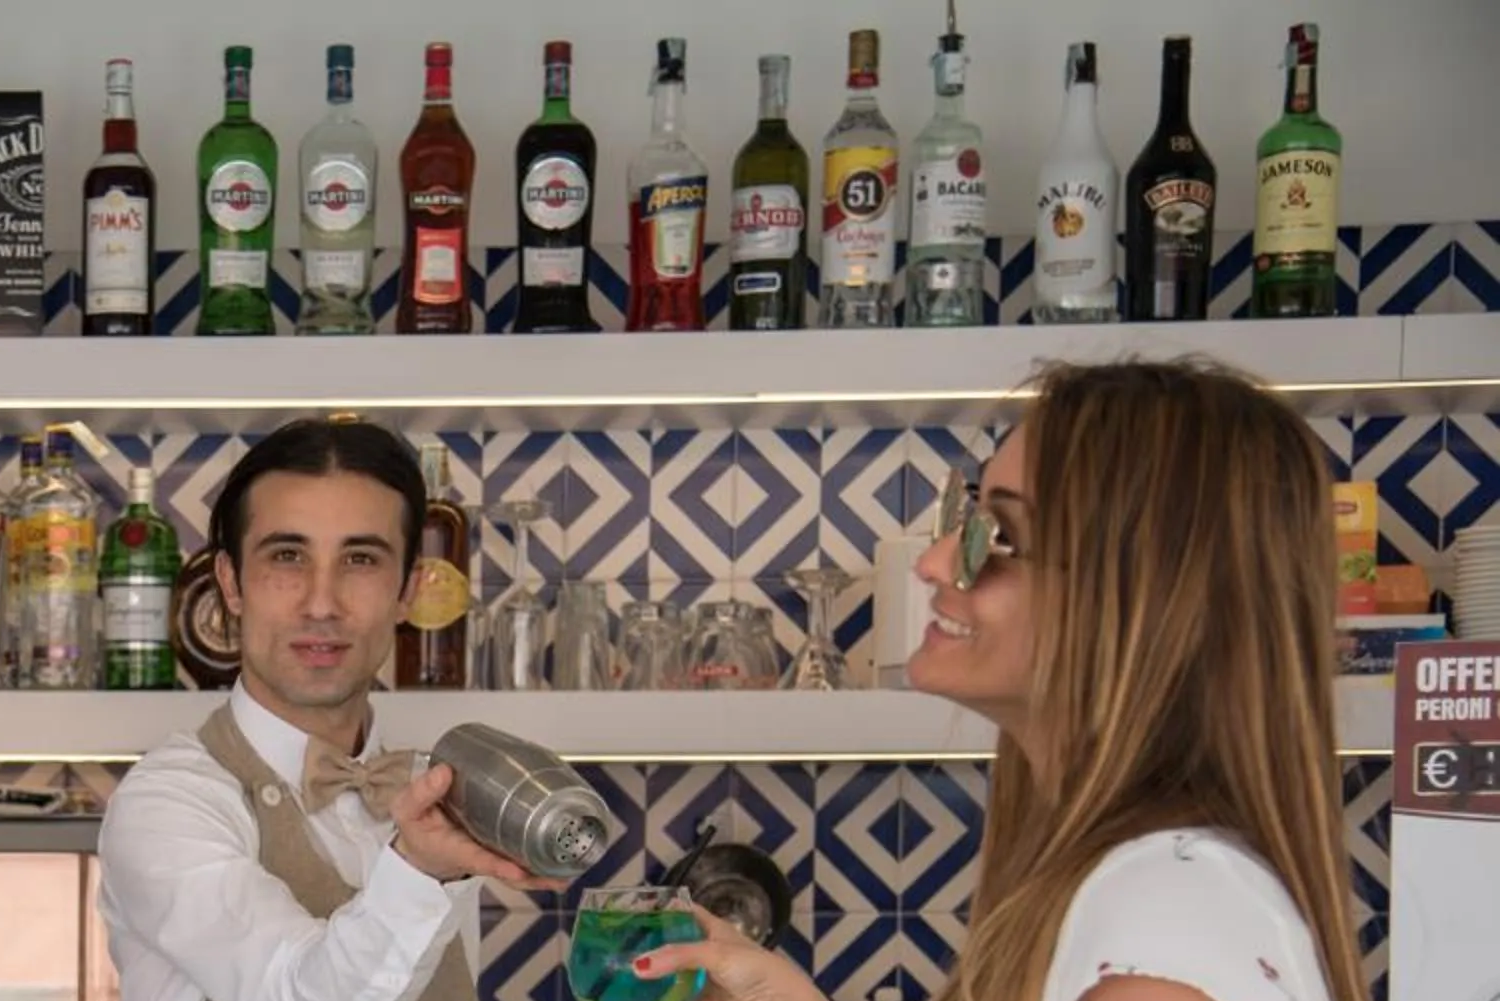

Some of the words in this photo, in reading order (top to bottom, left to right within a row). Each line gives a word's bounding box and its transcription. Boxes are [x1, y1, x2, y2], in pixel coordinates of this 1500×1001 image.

[1261, 159, 1333, 185] JAMESON
[213, 190, 268, 204] MARTINI
[308, 190, 364, 205] MARTINI
[413, 194, 465, 206] MARTINI
[528, 188, 584, 201] MARTINI
[847, 181, 876, 207] 51
[1037, 182, 1107, 210] MALIBU
[90, 208, 143, 231] PIMM'S
[1414, 697, 1492, 721] PERONI
